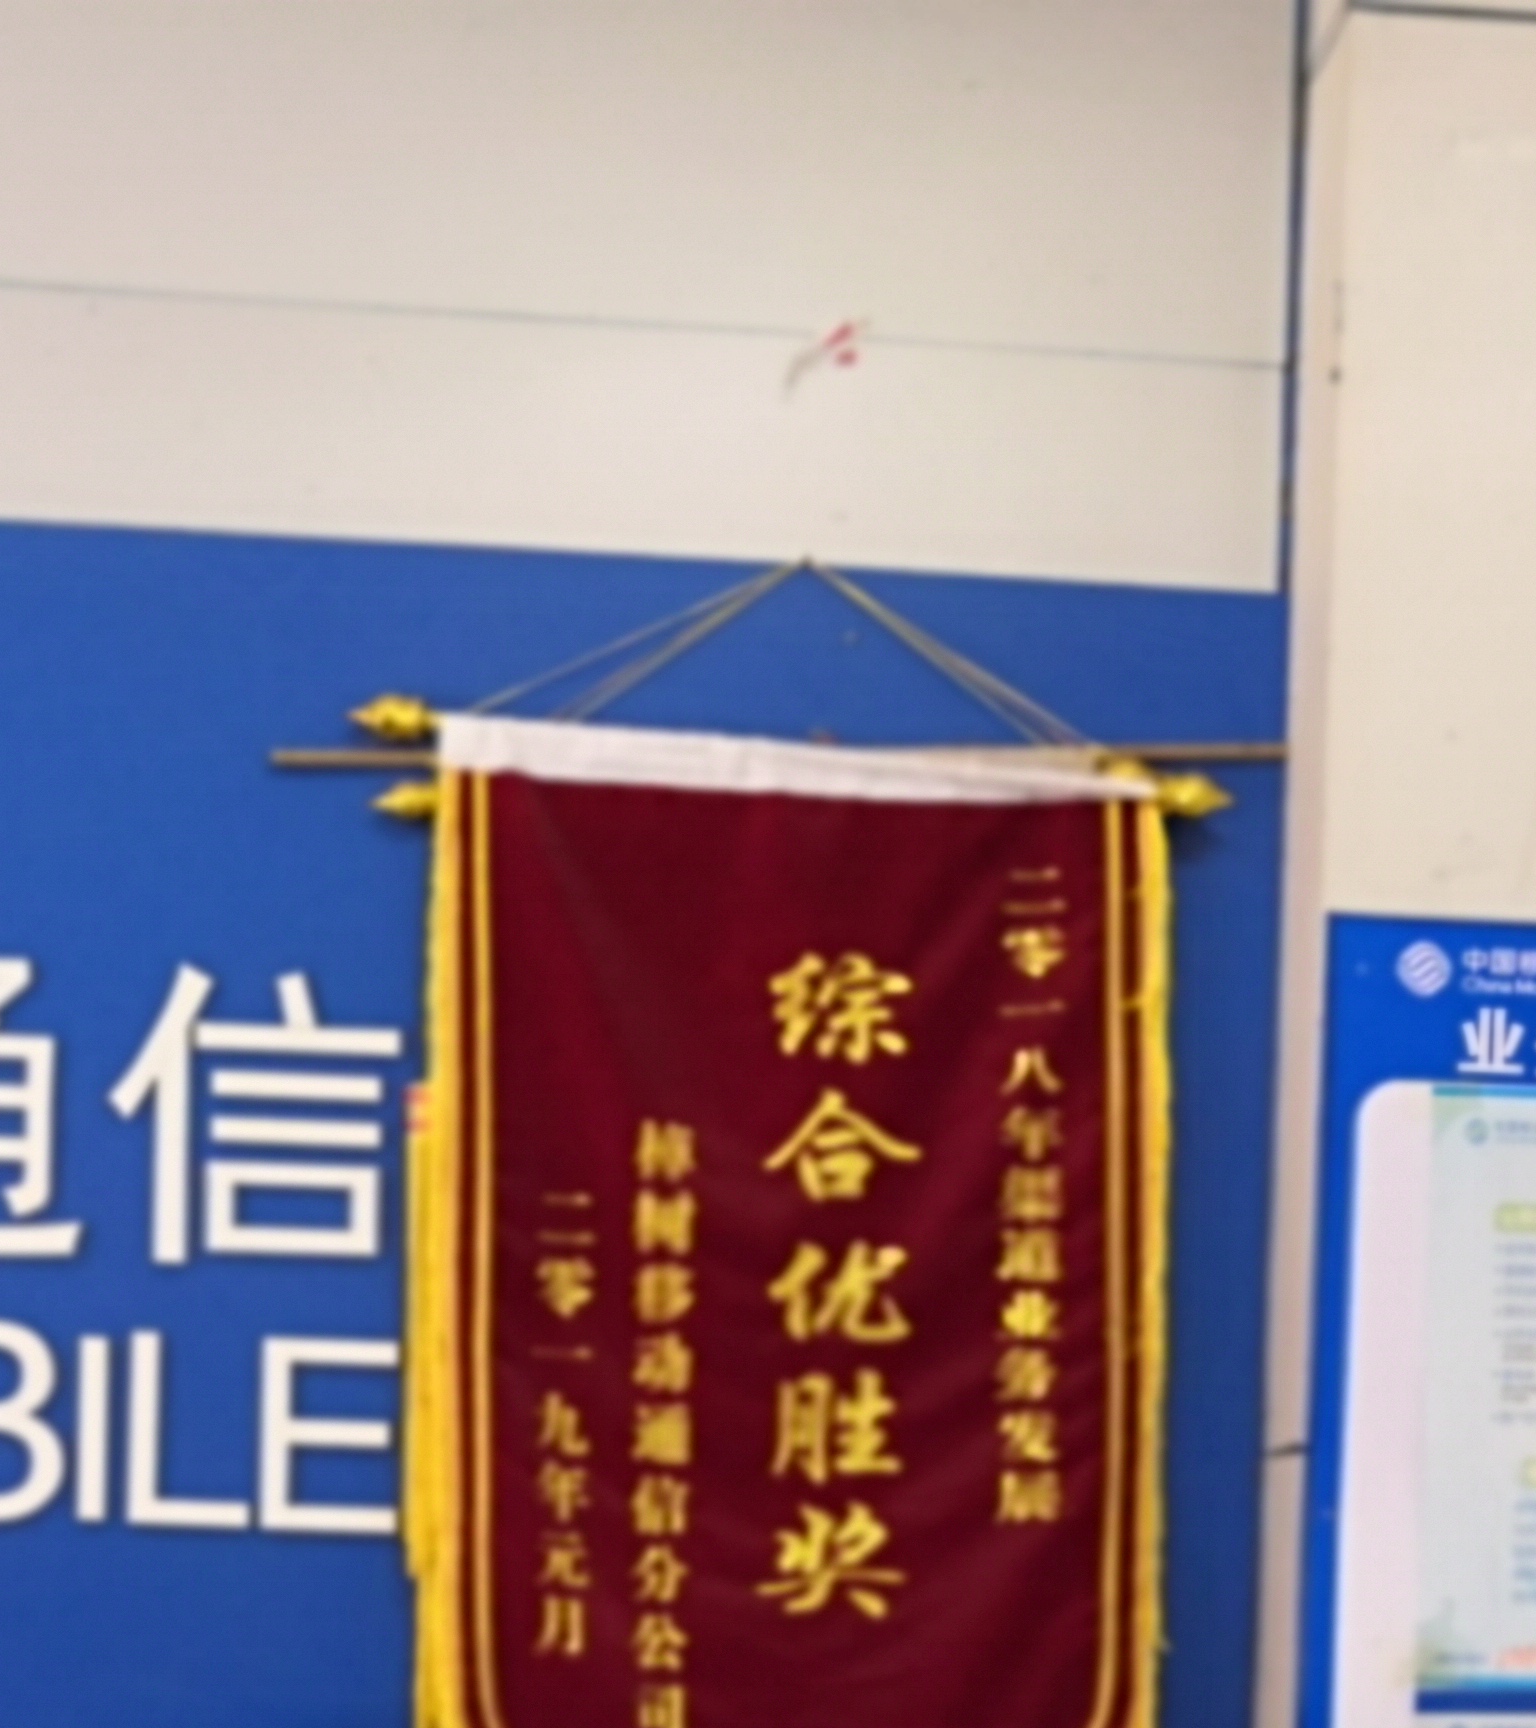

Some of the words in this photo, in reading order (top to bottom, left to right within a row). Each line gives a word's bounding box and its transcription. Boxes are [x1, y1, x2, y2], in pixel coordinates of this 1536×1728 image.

[531, 1192, 596, 1657] 二零一九年元月
[756, 950, 924, 1621] 综合优胜奖
